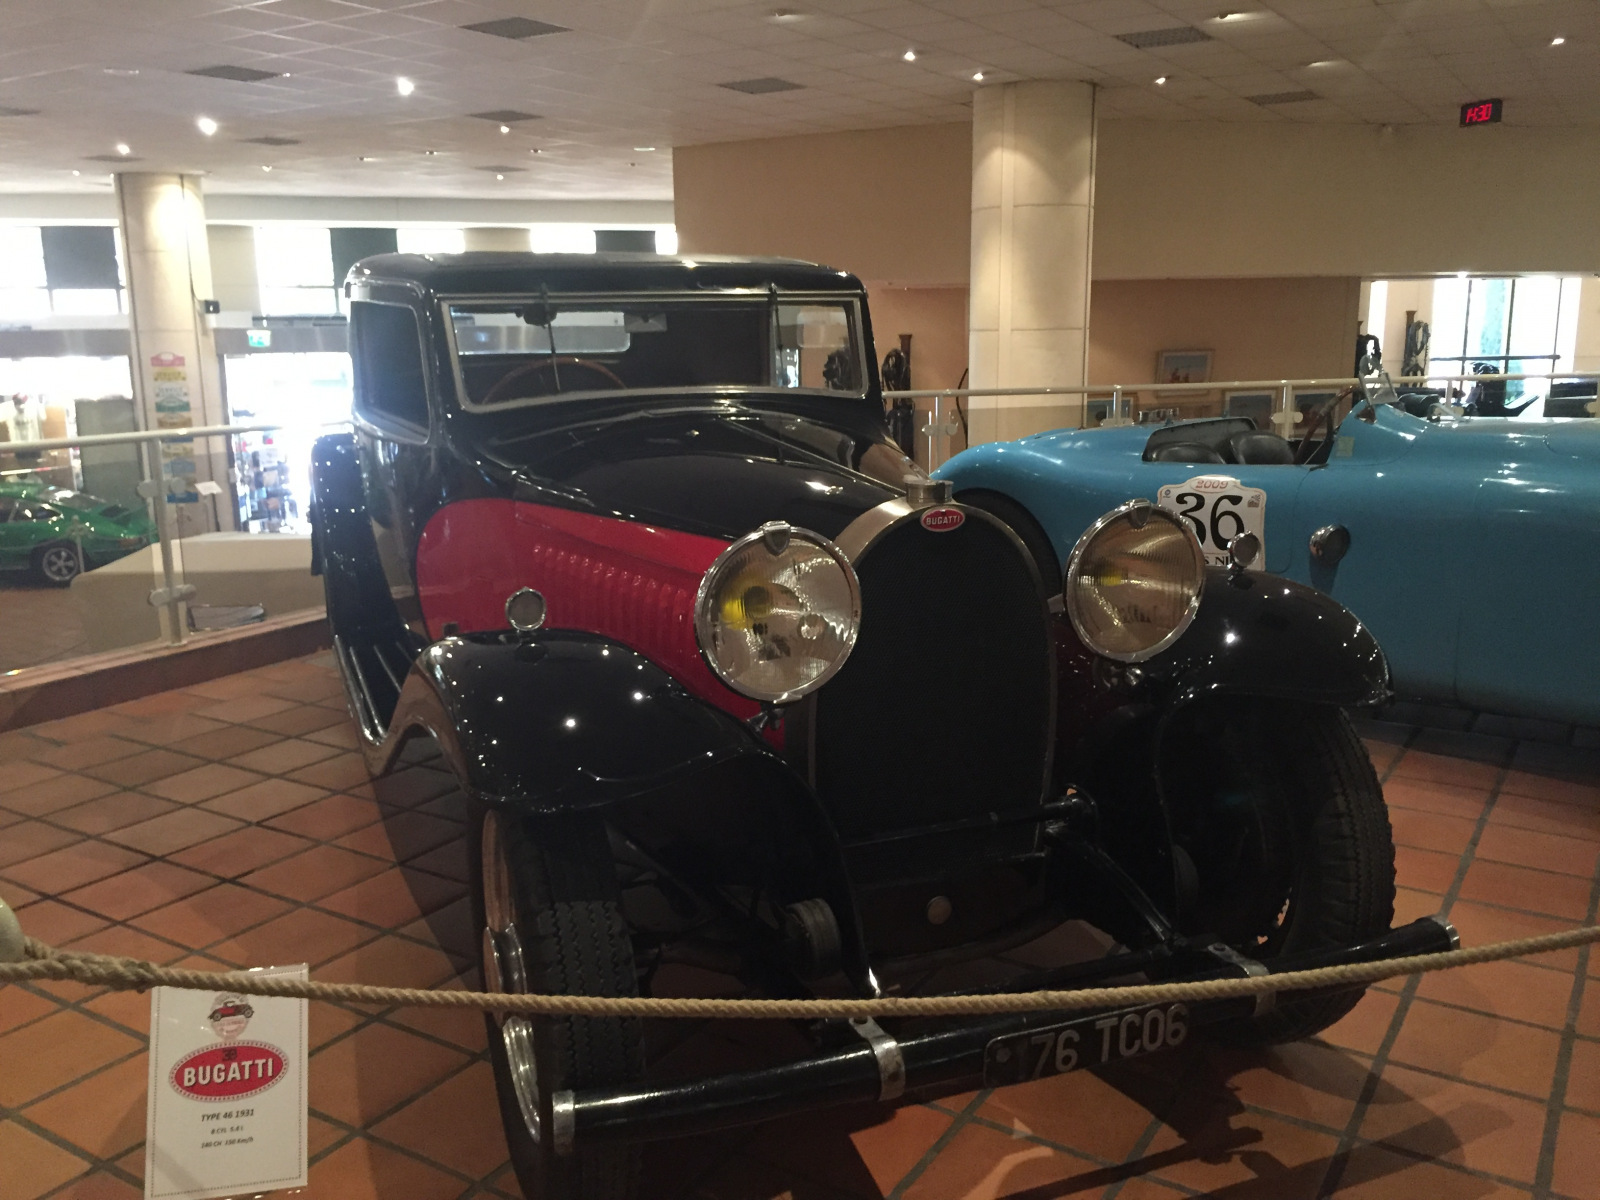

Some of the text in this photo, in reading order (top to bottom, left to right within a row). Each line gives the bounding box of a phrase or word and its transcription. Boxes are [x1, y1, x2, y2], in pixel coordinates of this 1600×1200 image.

[1195, 480, 1228, 489] 2009
[926, 515, 960, 526] BUGATTI
[1176, 492, 1245, 551] 36
[183, 1057, 274, 1088] BUGATTI
[201, 1108, 255, 1122] TYPE 46 1931
